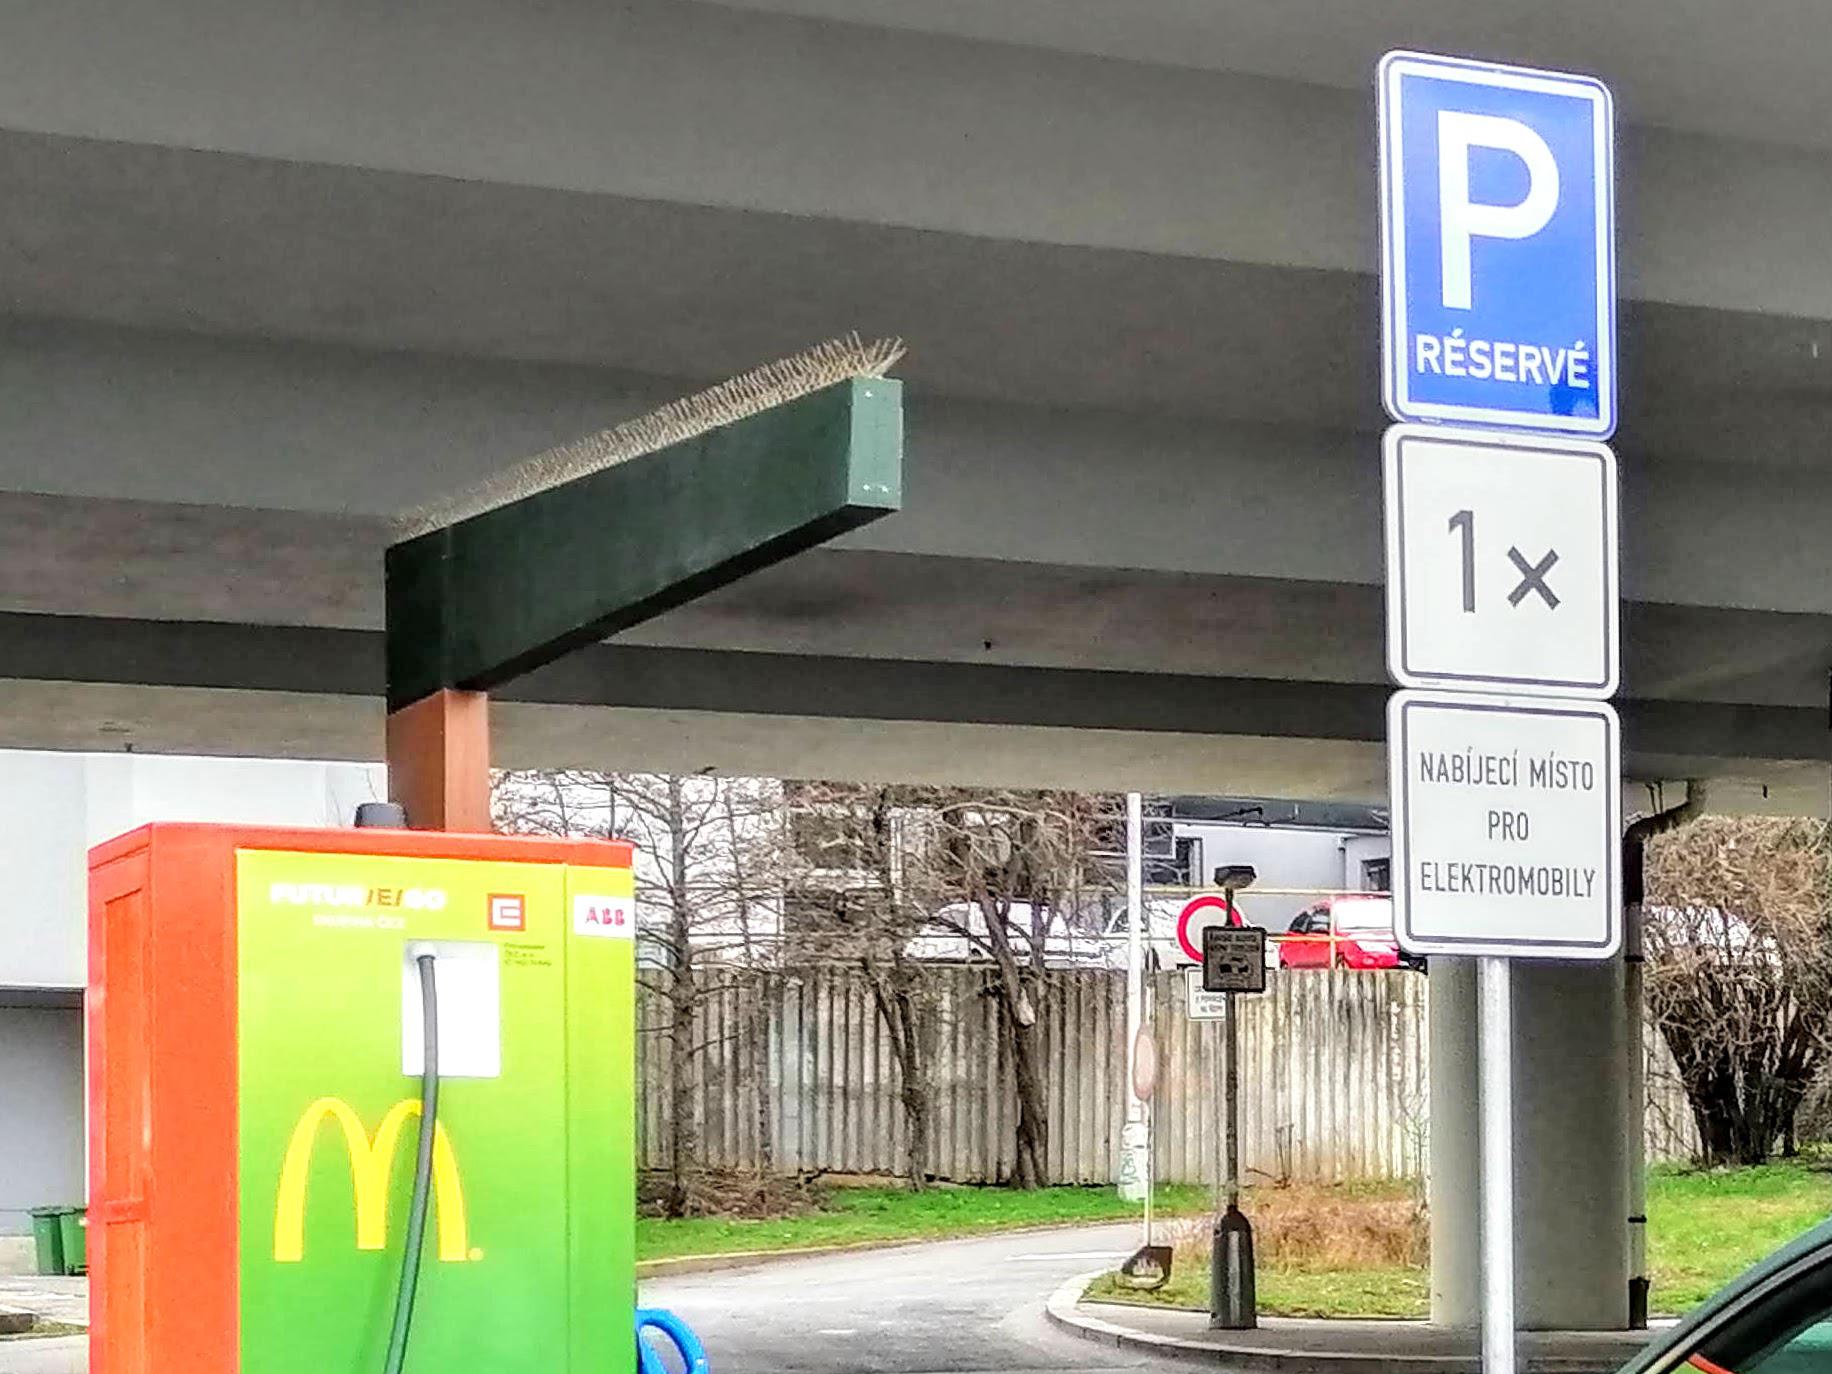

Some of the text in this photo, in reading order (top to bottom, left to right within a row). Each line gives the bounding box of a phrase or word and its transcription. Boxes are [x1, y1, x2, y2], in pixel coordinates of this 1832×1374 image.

[1436, 109, 1560, 311] P
[1415, 328, 1590, 389] RÉSERVÉ
[1419, 746, 1595, 791] NABÍJECÍ MÍSTO
[1488, 810, 1529, 842] PRO
[1420, 861, 1596, 898] ELEKTROMOBILY
[585, 907, 626, 927] ABB
